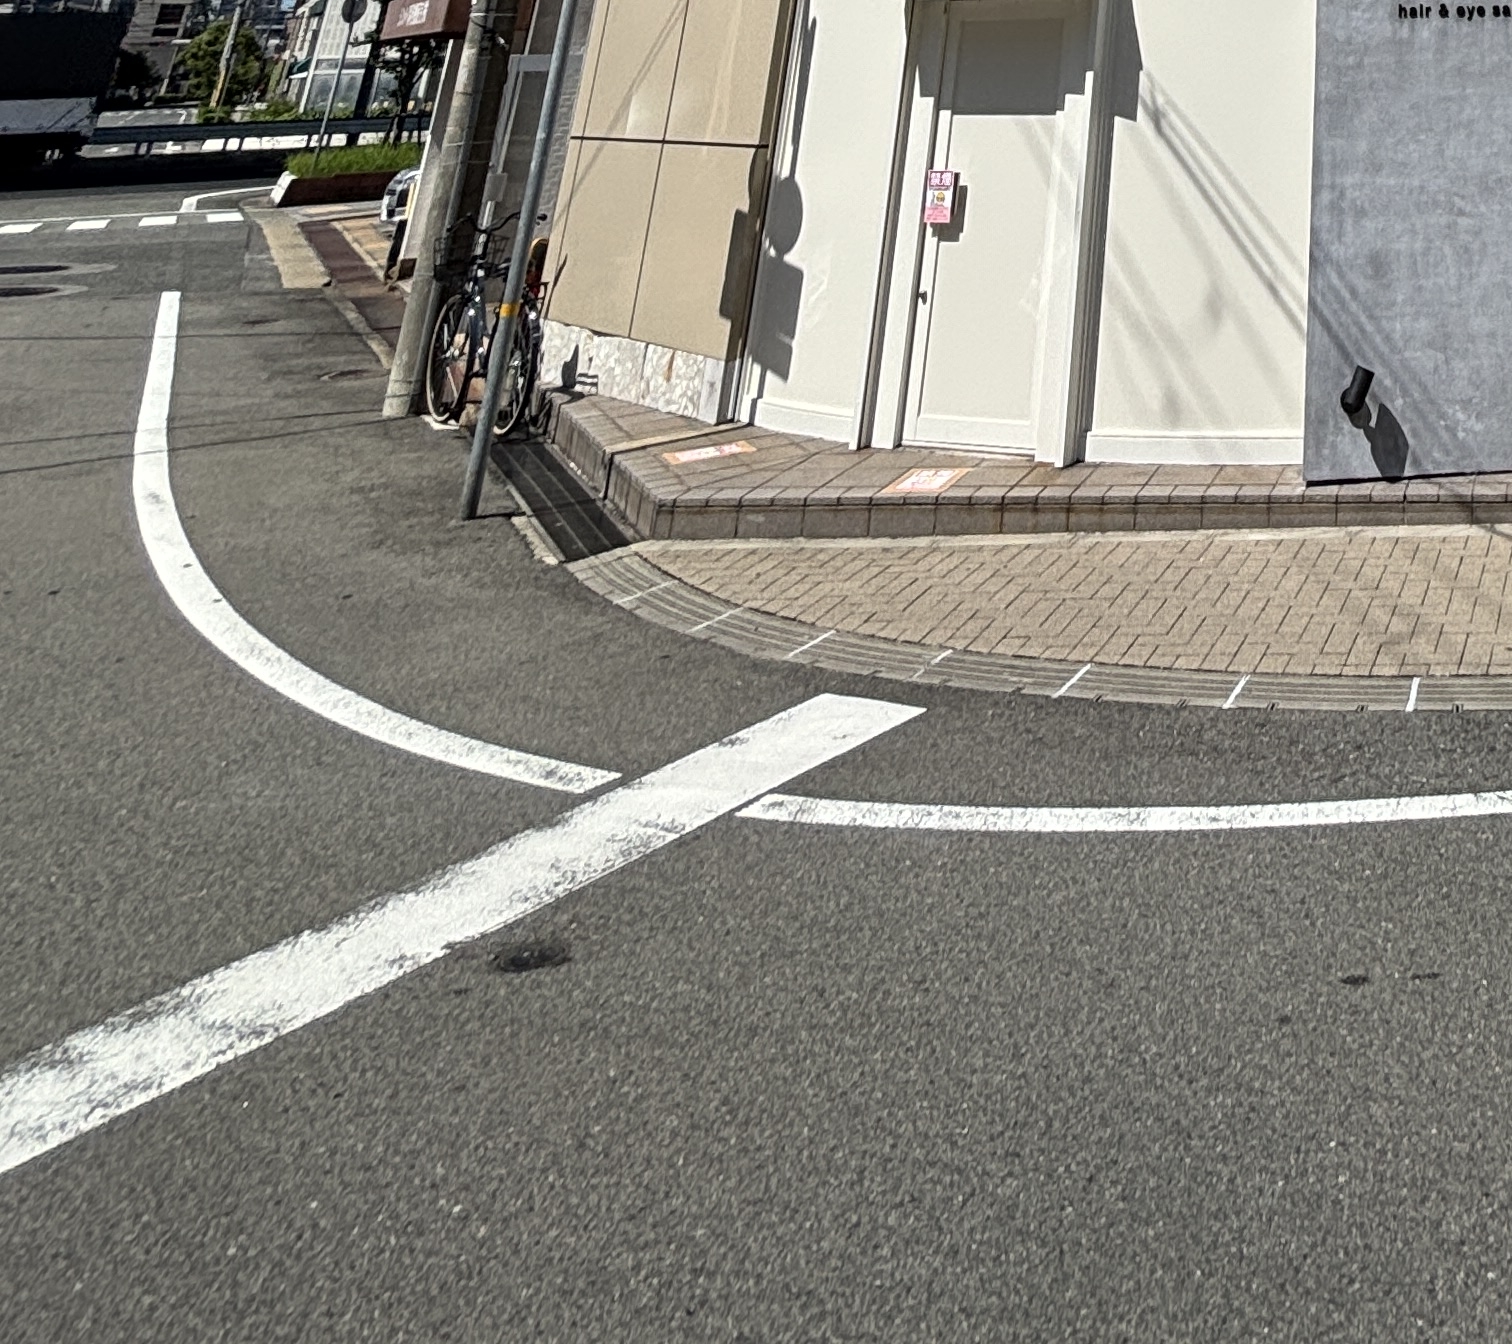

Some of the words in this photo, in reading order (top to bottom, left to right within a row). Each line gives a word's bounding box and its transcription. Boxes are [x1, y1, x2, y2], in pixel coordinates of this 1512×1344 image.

[1398, 3, 1432, 19] hair
[1438, 3, 1450, 19] &
[1456, 4, 1486, 22] eye
